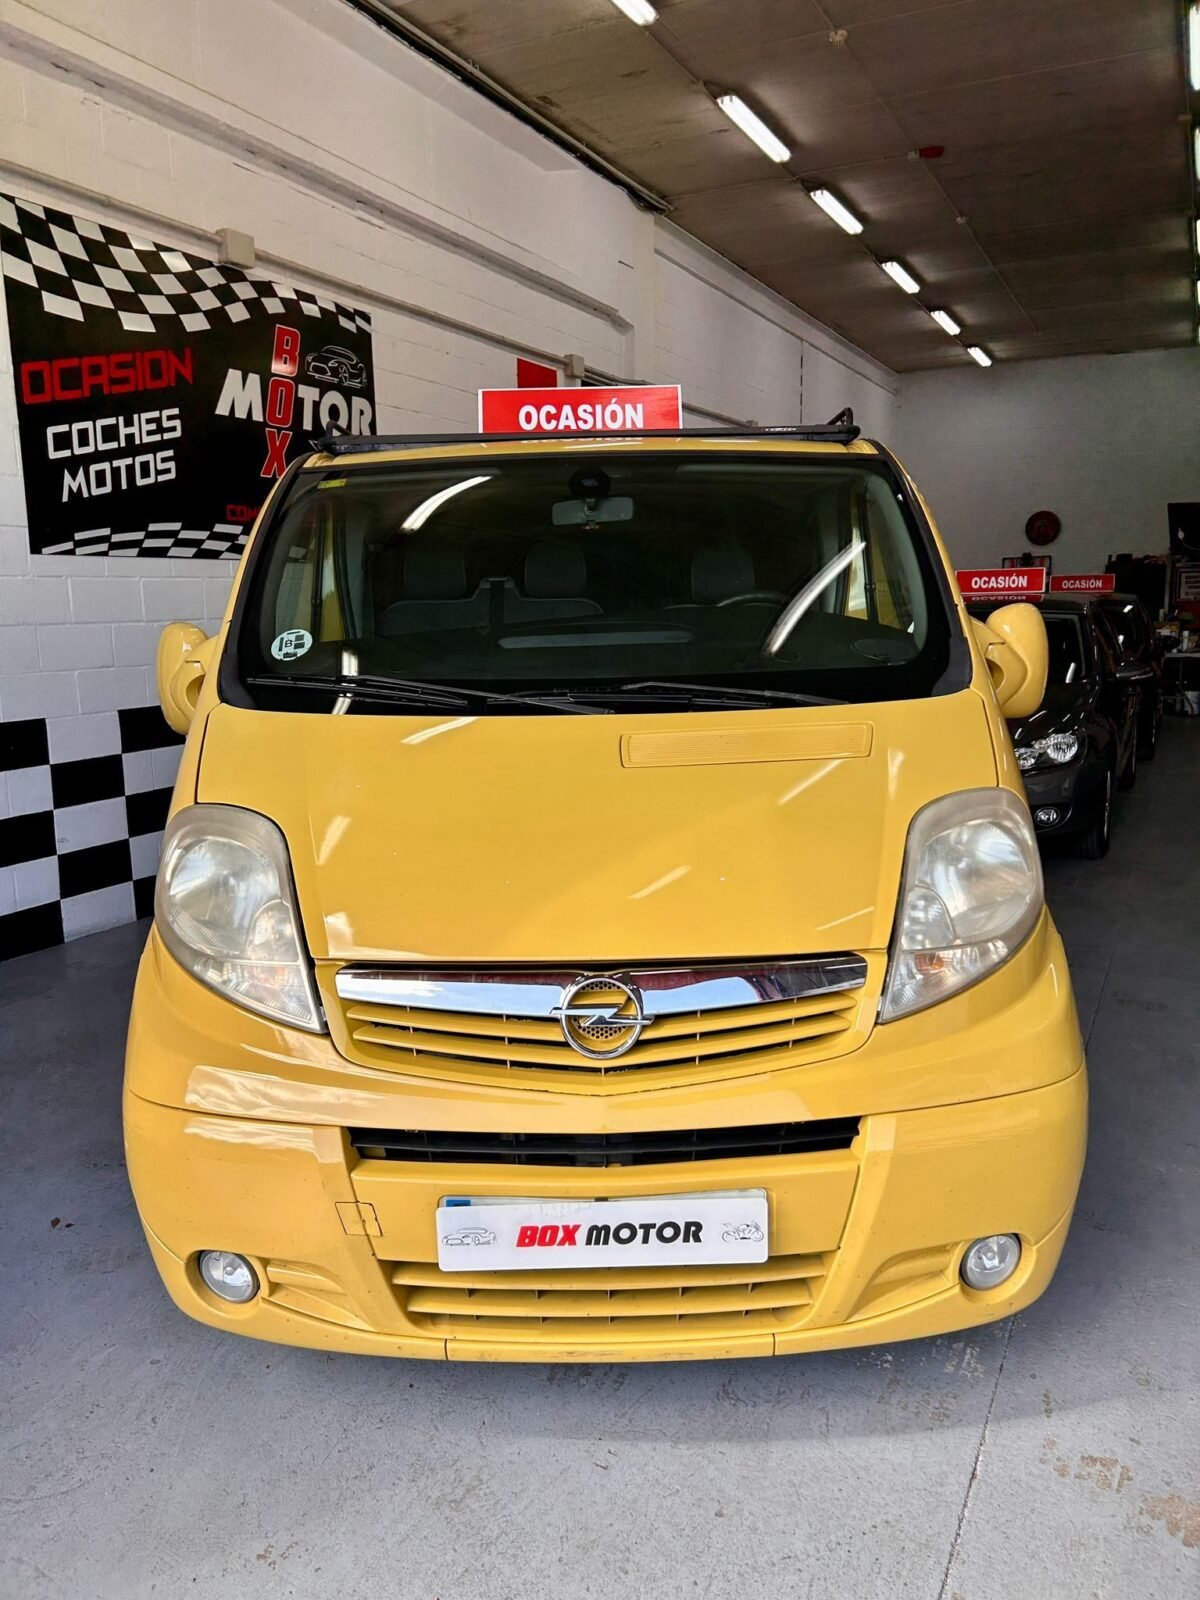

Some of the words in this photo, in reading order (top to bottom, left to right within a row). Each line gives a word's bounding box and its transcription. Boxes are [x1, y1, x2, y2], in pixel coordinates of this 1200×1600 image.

[20, 348, 194, 405] OCASION
[260, 323, 301, 479] BOX
[518, 397, 644, 431] OCASIÓN
[46, 407, 182, 460] COCHES
[62, 449, 177, 503] MOTOS
[971, 573, 1028, 590] OCASIÓN
[1061, 578, 1103, 589] OCASIÓN
[284, 639, 293, 648] B
[515, 1223, 582, 1248] BOX
[584, 1221, 704, 1247] MOTOR
